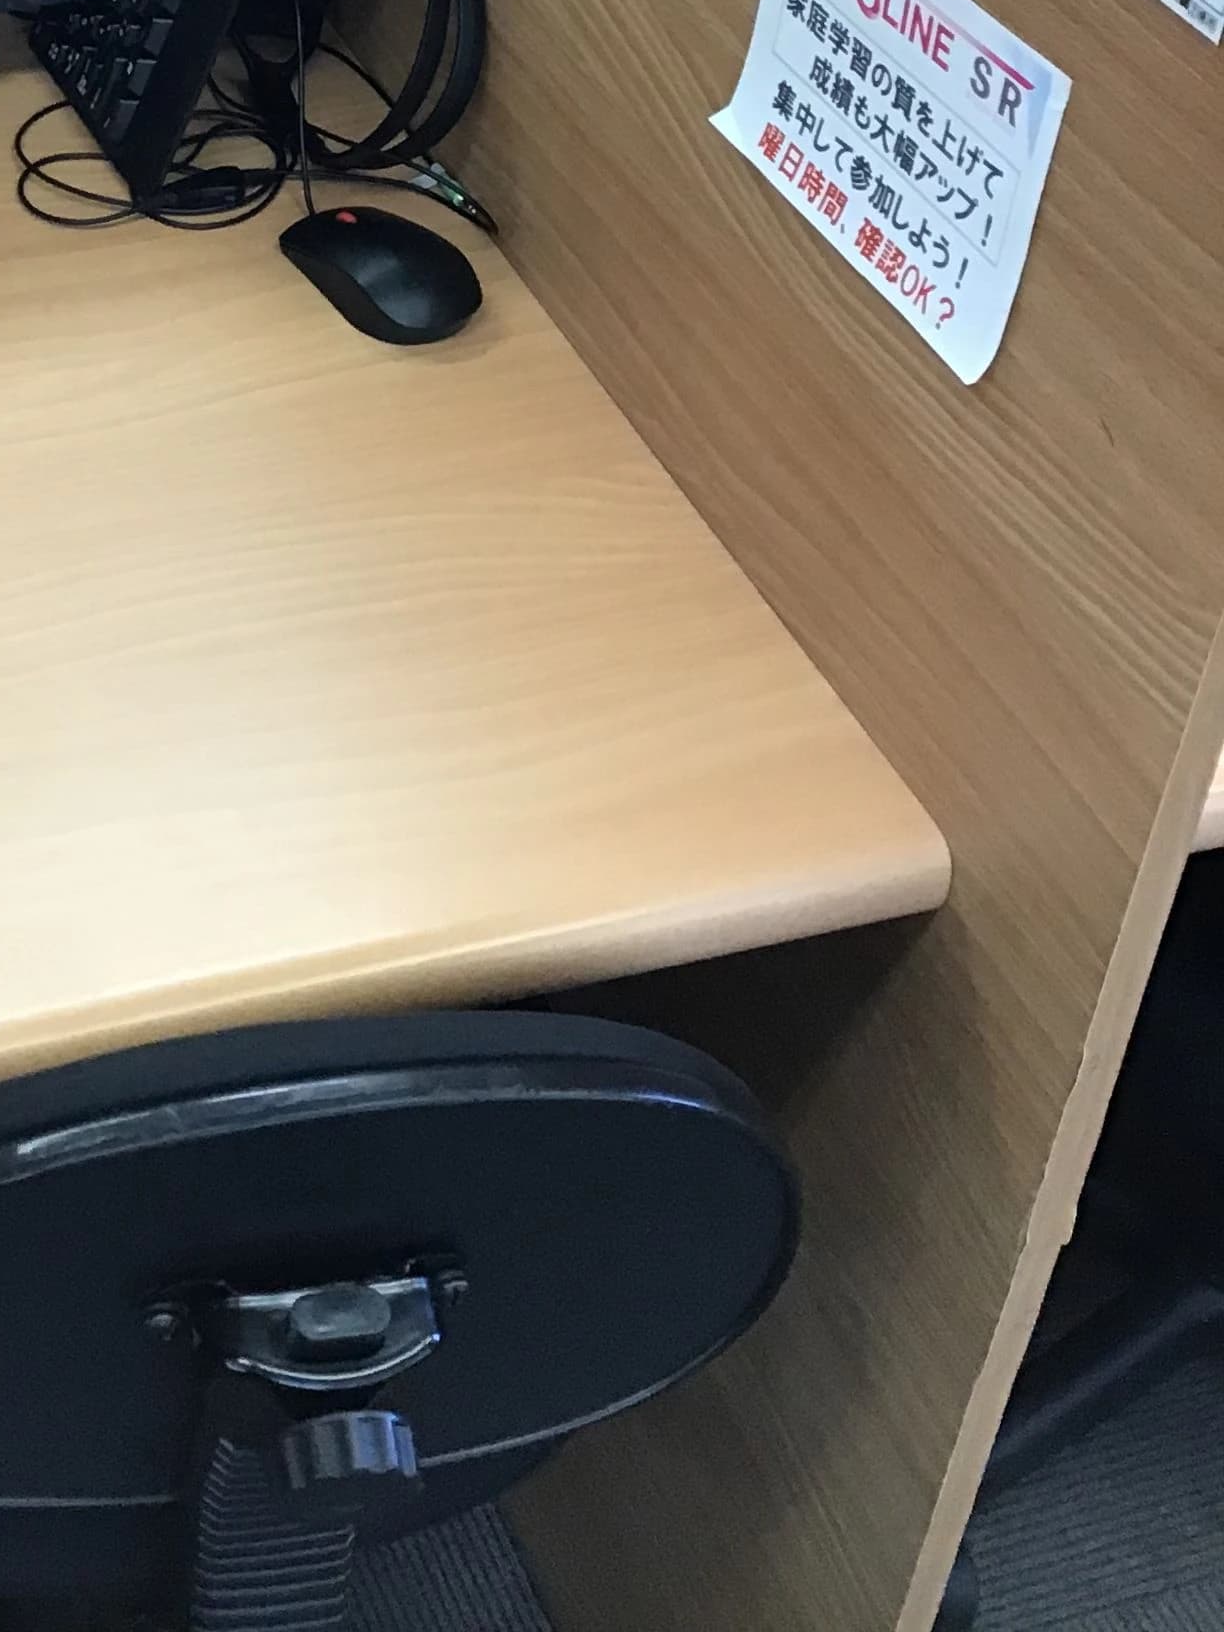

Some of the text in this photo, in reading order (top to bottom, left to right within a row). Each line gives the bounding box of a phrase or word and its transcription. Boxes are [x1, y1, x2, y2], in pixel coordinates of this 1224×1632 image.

[773, 81, 969, 290] 集中して参加しよう！
[809, 55, 994, 248] 成績も大幅アップ！
